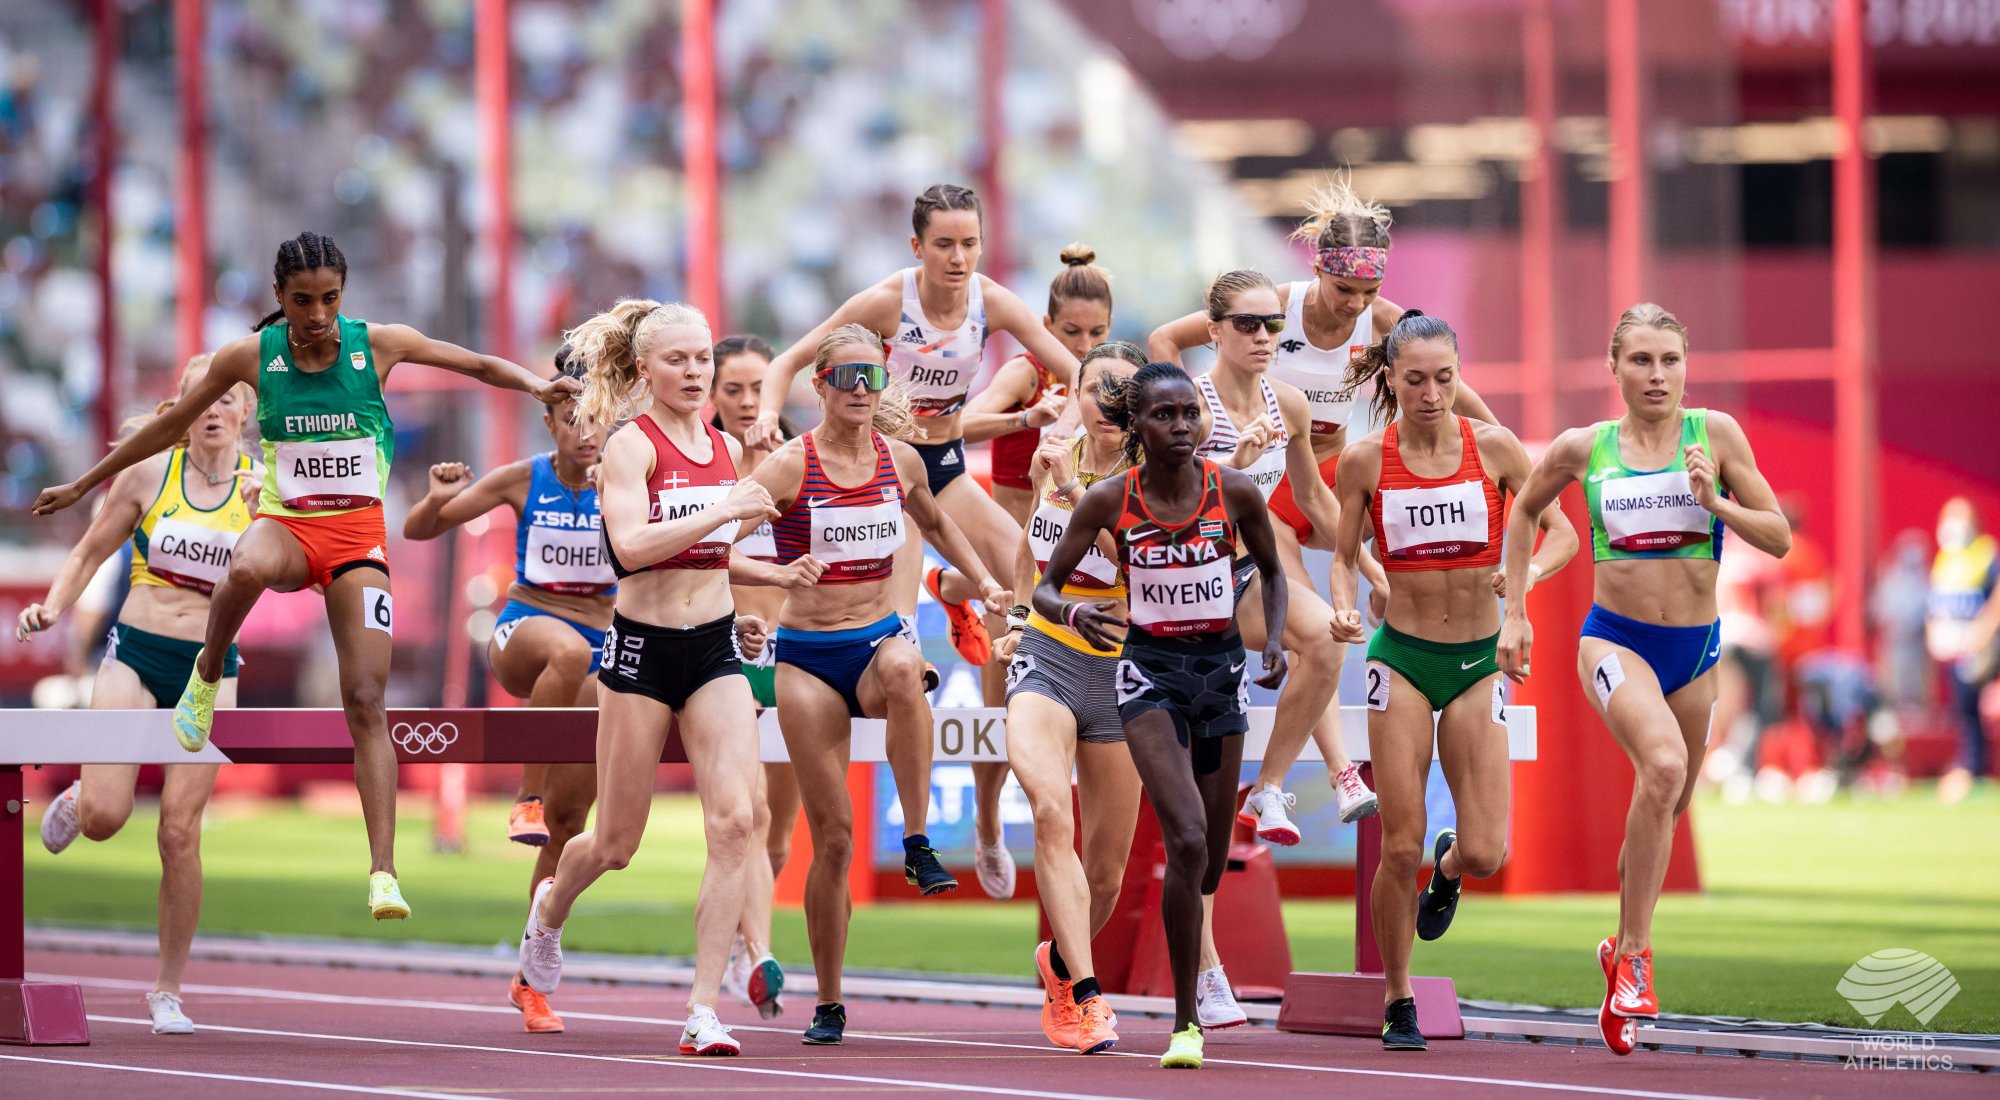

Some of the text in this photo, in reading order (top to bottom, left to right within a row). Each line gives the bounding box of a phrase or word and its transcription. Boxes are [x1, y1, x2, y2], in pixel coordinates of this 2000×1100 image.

[901, 335, 927, 345] adidas
[1280, 339, 1306, 353] 4F
[910, 365, 959, 386] BIRD
[1303, 388, 1353, 403] NIECZEK
[285, 413, 357, 433] ETHIOPIA
[293, 455, 362, 479] ABEBE
[533, 511, 601, 529] ISRAE
[1405, 500, 1465, 528] TOTH
[824, 520, 897, 543] CONSTIEN
[1129, 540, 1219, 565] KENYA
[1141, 577, 1223, 605] KIYENG
[374, 593, 391, 628] 6
[619, 635, 645, 681] DEN
[1122, 665, 1143, 694] 5
[1367, 668, 1381, 706] 2
[1597, 666, 1611, 693] 1
[932, 718, 1007, 756] OK
